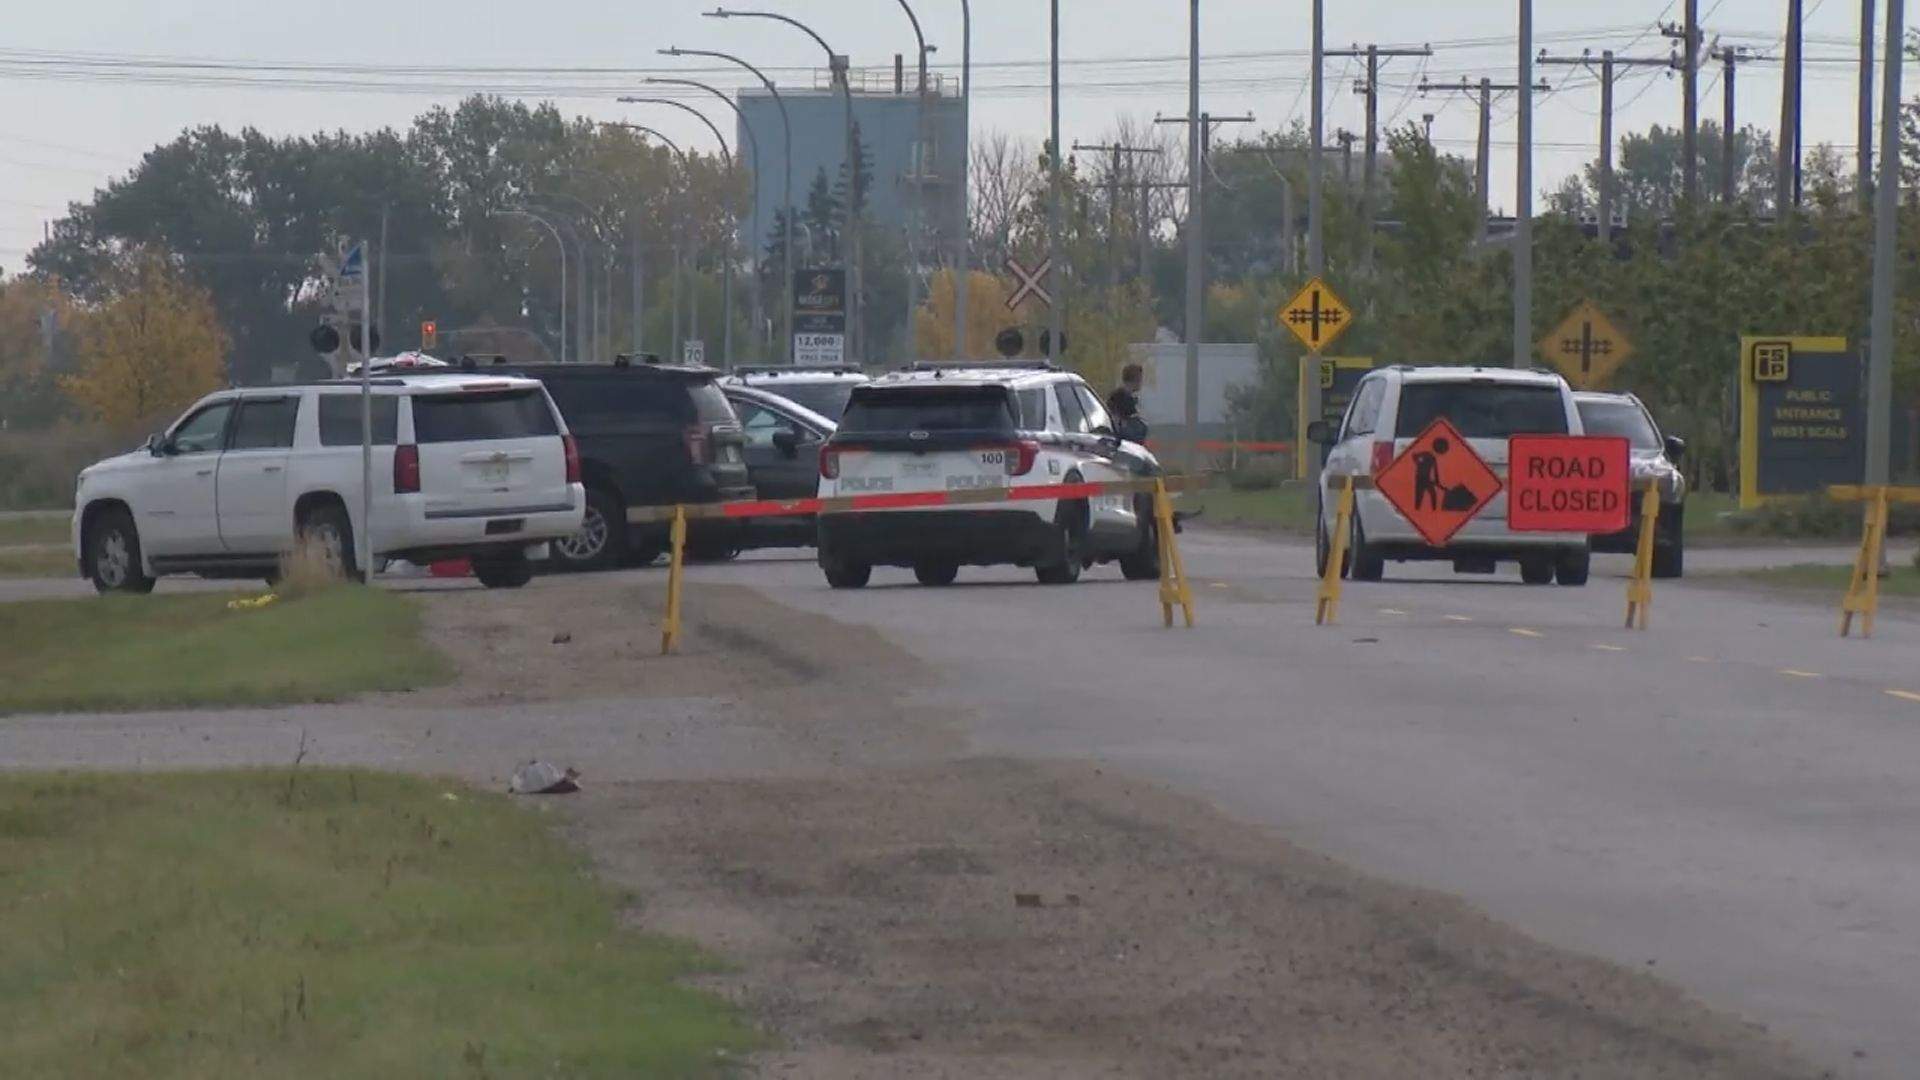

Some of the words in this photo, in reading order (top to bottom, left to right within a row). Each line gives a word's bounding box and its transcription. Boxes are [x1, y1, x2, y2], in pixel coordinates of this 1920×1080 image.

[687, 348, 702, 362] 70
[1785, 389, 1830, 401] PUBLIC
[1775, 408, 1841, 420] ENTRANCE
[1771, 426, 1805, 438] WEST
[981, 453, 1003, 464] 100
[1529, 456, 1605, 479] ROAD
[841, 477, 893, 491] POLICE
[946, 475, 1003, 489] POLICE
[1519, 488, 1618, 512] CLOSED
